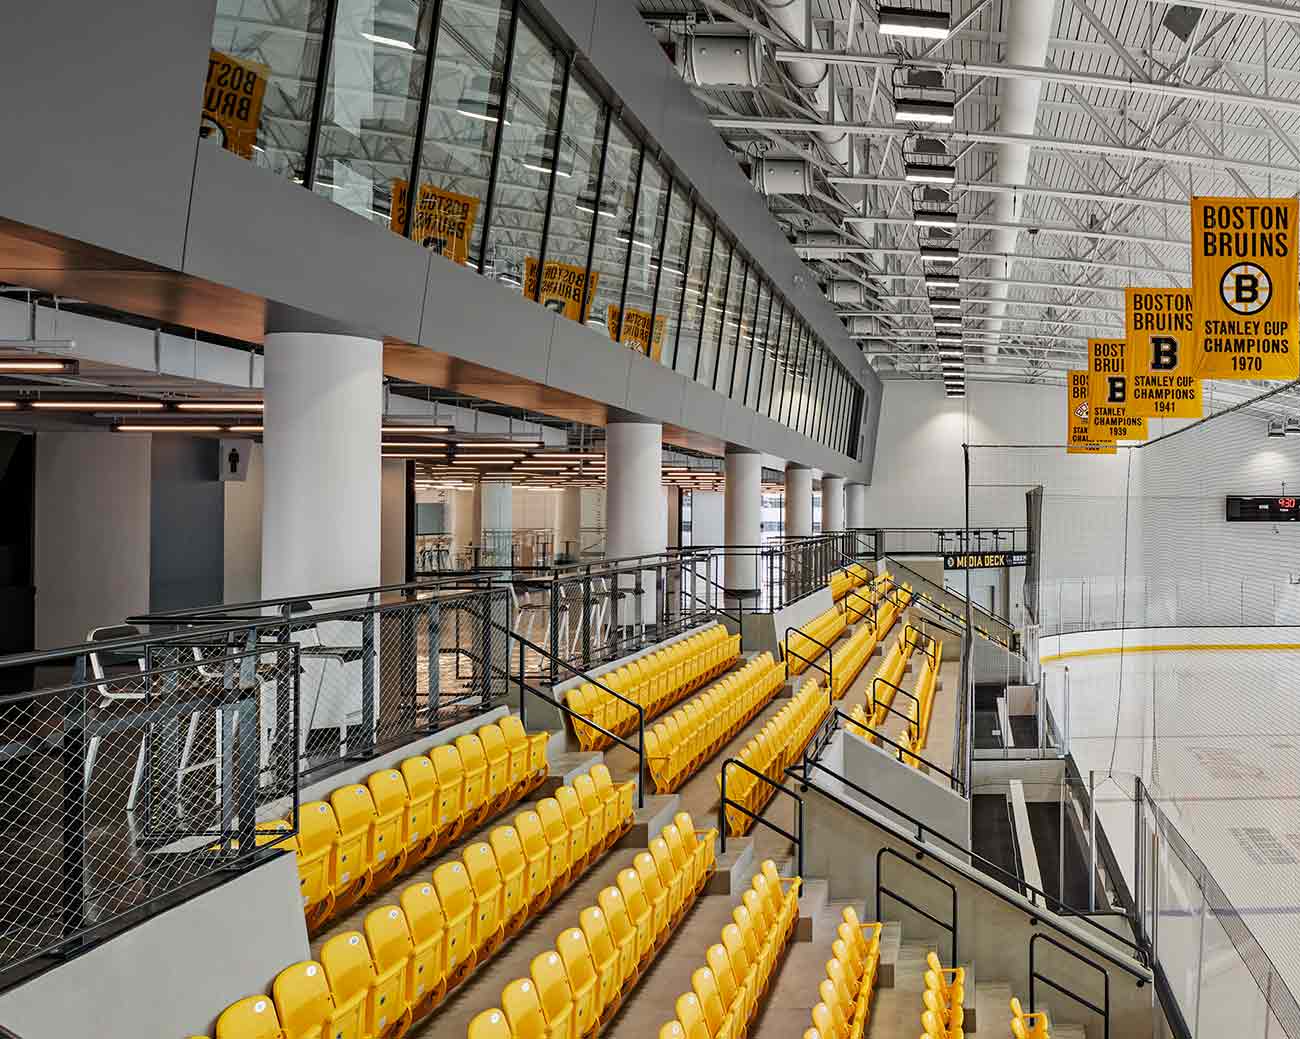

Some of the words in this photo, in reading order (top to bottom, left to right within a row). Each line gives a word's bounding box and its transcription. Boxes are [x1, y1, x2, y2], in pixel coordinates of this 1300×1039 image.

[1203, 205, 1288, 229] BOSTON
[1203, 232, 1288, 257] BRUINS
[1235, 274, 1259, 304] B
[1133, 294, 1192, 312] BOSTON
[1133, 313, 1192, 331] BRUINS
[1205, 320, 1260, 336] STANLEY
[1264, 321, 1288, 336] CUP
[1094, 344, 1125, 357] BOST
[1151, 337, 1178, 369] B
[1203, 338, 1289, 354] CHAMPIONS
[1094, 358, 1124, 372] BRUI
[1231, 357, 1262, 371] 1970
[1134, 376, 1174, 387] STANLEY
[1177, 376, 1194, 387] CUP
[1134, 388, 1195, 400] CHAMPIONS
[1094, 407, 1125, 416] STANLEY
[1154, 401, 1176, 412] 1941
[1094, 417, 1143, 426] CHAMPIONS
[1073, 426, 1088, 434] STAN
[1110, 427, 1127, 436] 1939
[984, 554, 1005, 567] DECK
